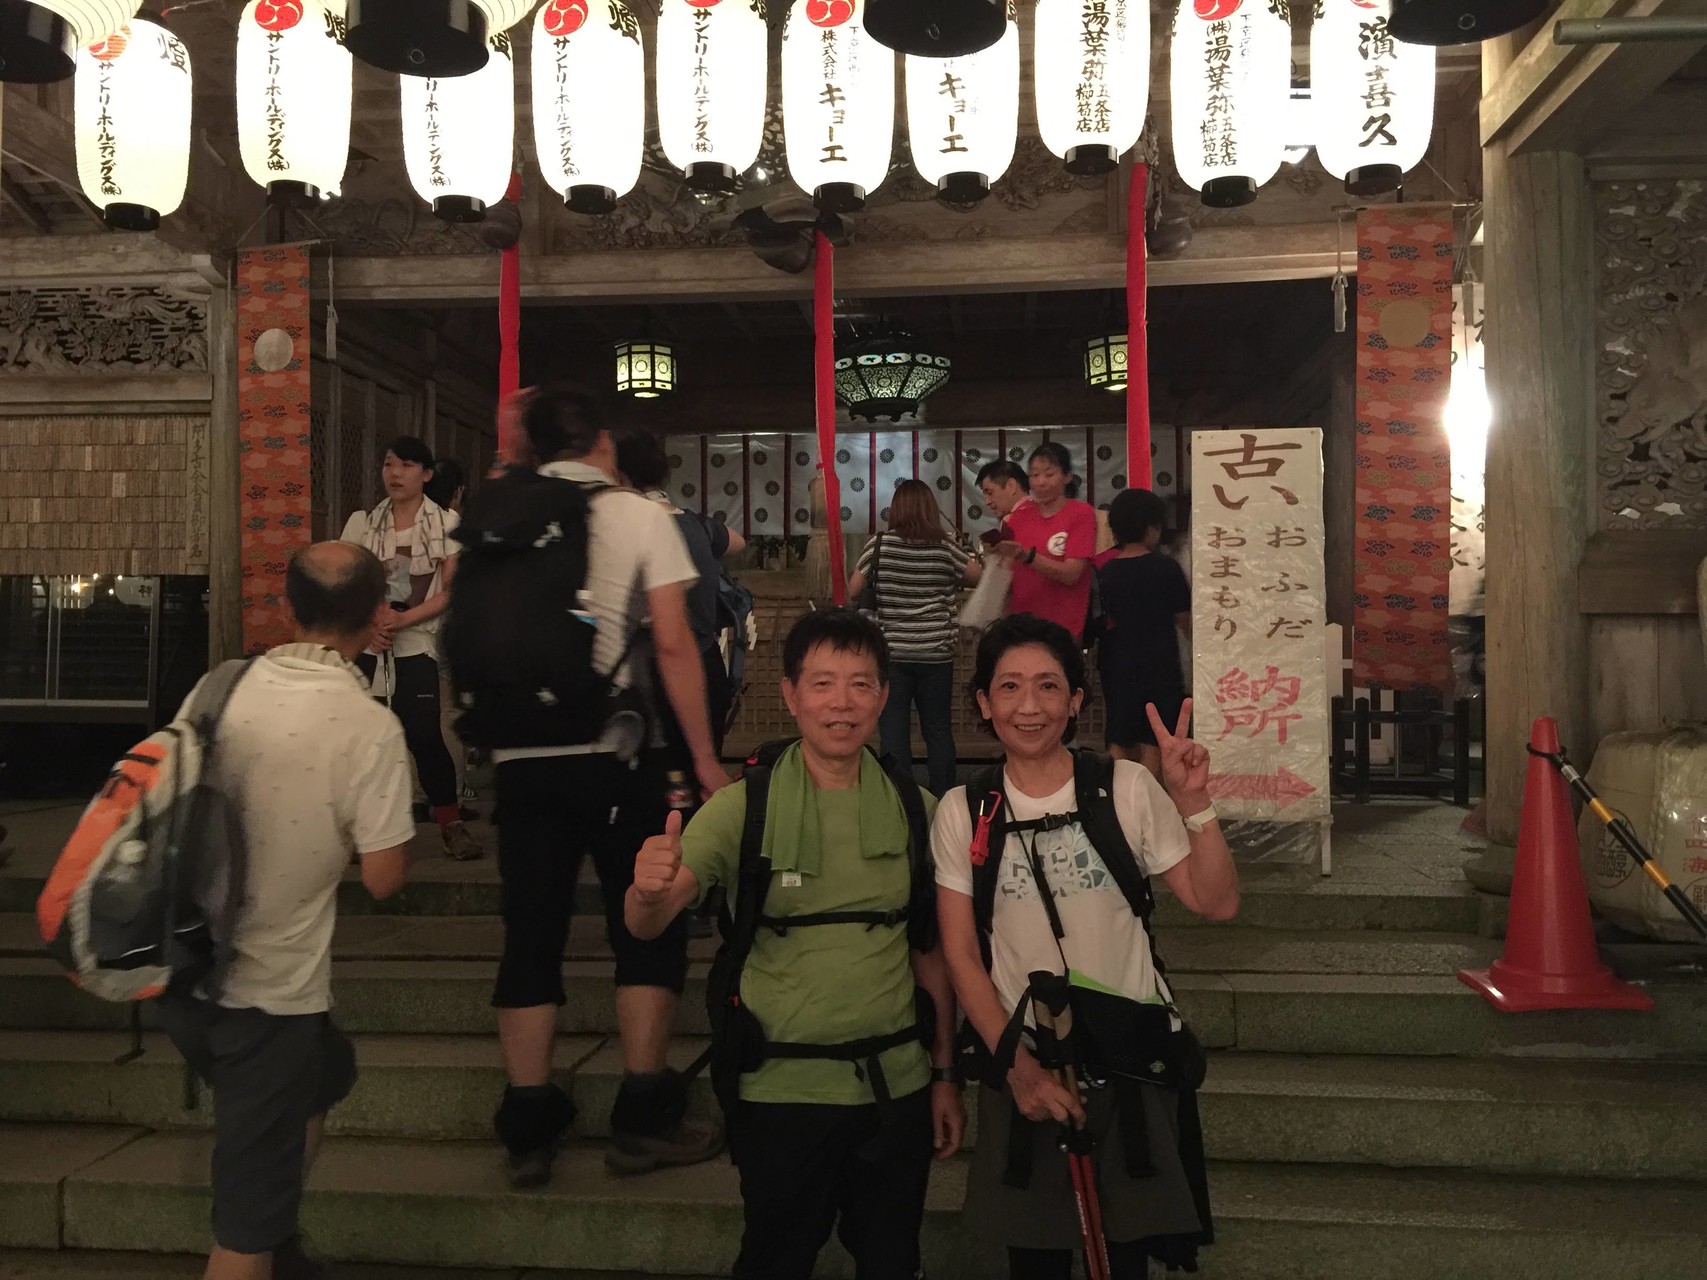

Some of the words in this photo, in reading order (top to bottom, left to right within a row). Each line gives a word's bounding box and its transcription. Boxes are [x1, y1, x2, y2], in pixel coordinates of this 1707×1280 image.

[553, 36, 581, 177] サントリーホールディングス株)
[691, 8, 714, 153] サントリーホールデングス(株)
[1203, 433, 1302, 510] 古い
[1207, 526, 1247, 641] おまもり
[1260, 525, 1313, 639] おふだ
